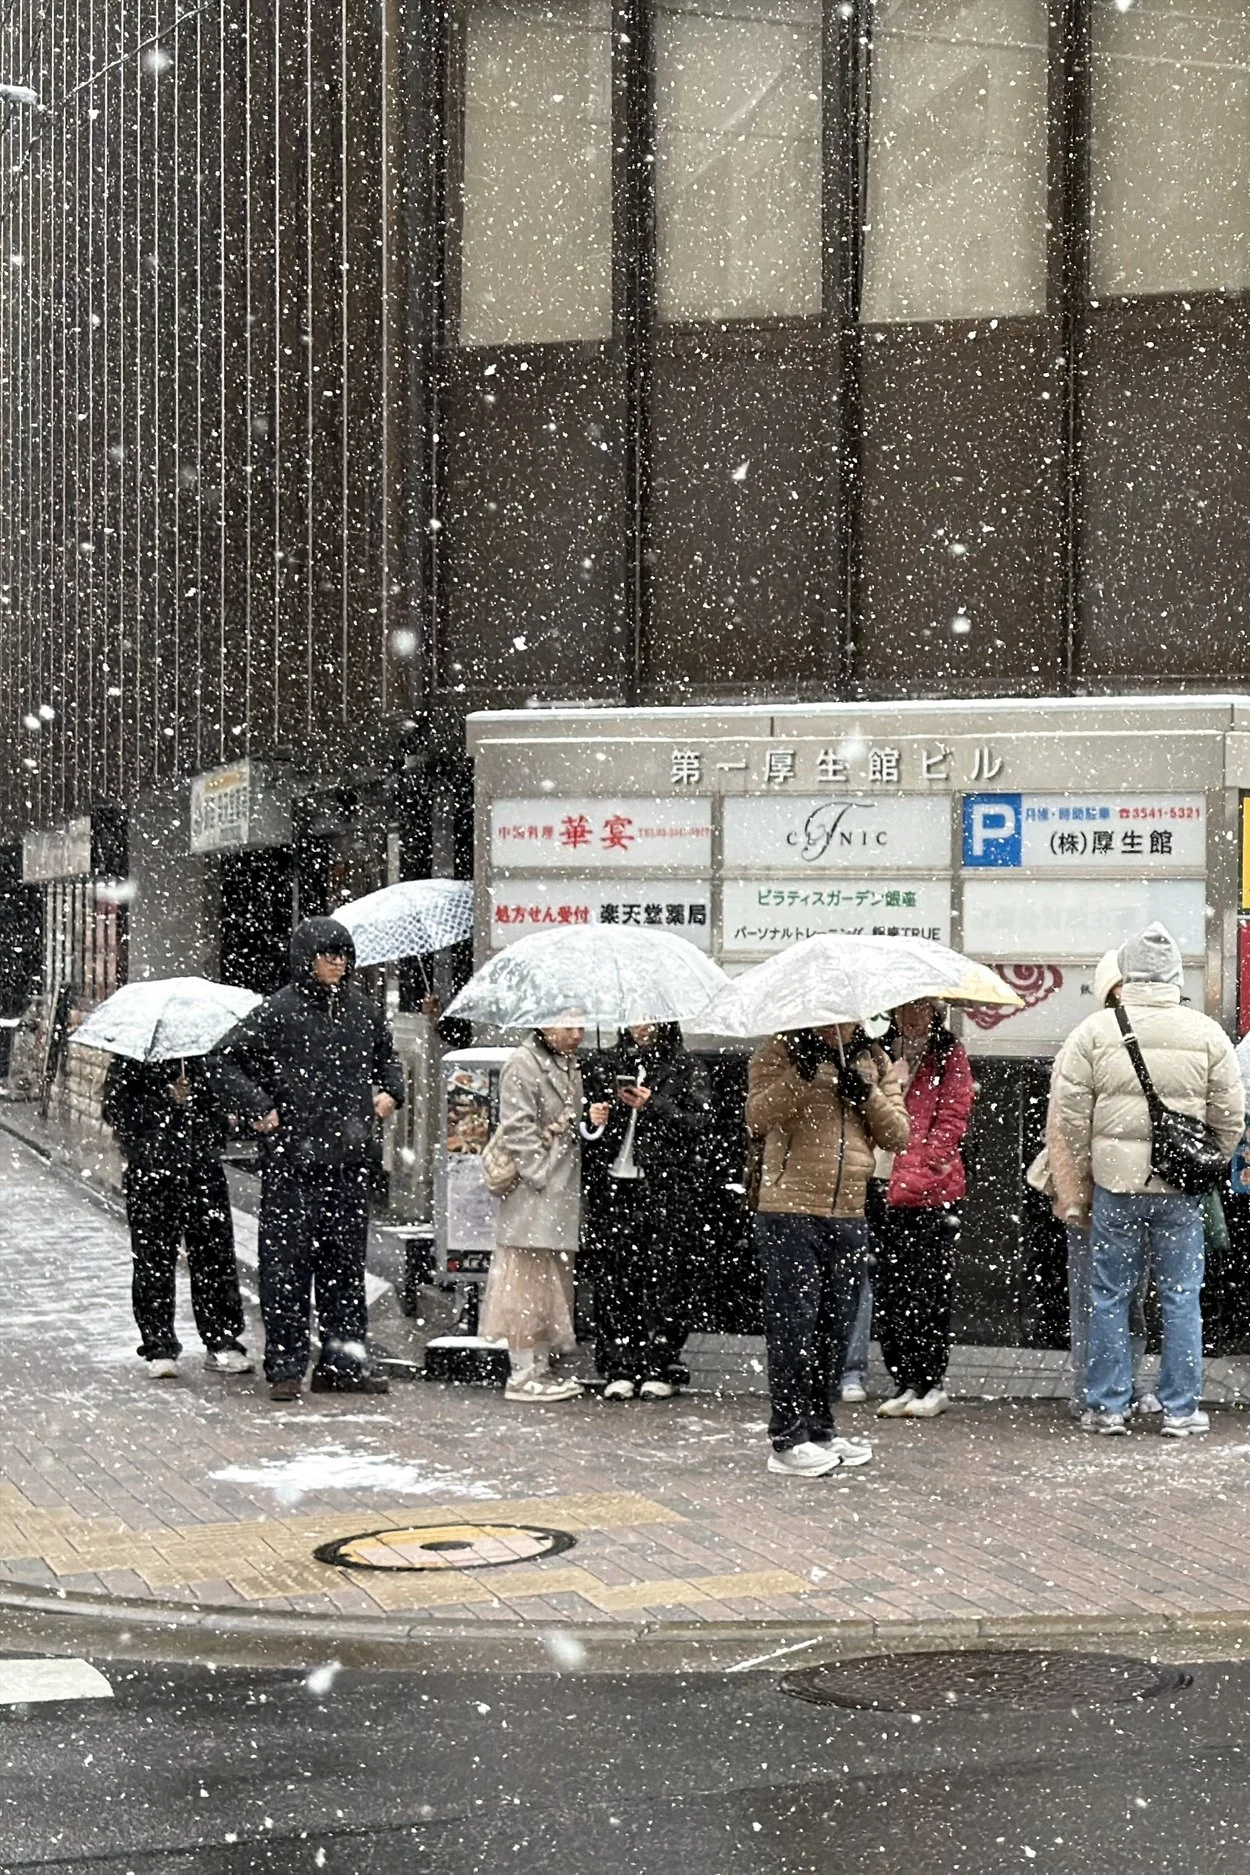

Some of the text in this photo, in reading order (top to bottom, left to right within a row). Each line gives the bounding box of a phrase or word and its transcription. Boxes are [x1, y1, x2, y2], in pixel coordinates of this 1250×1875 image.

[671, 749, 1003, 786] 第一厚生館ビル
[560, 815, 634, 849] 華宴
[786, 831, 888, 846] CLINIC
[972, 803, 1015, 856] P
[1049, 830, 1173, 855] (株)厚生館
[757, 890, 917, 908] ピラティスガーデン銀座
[496, 903, 707, 926] 処方せん受付 楽天堂薬局
